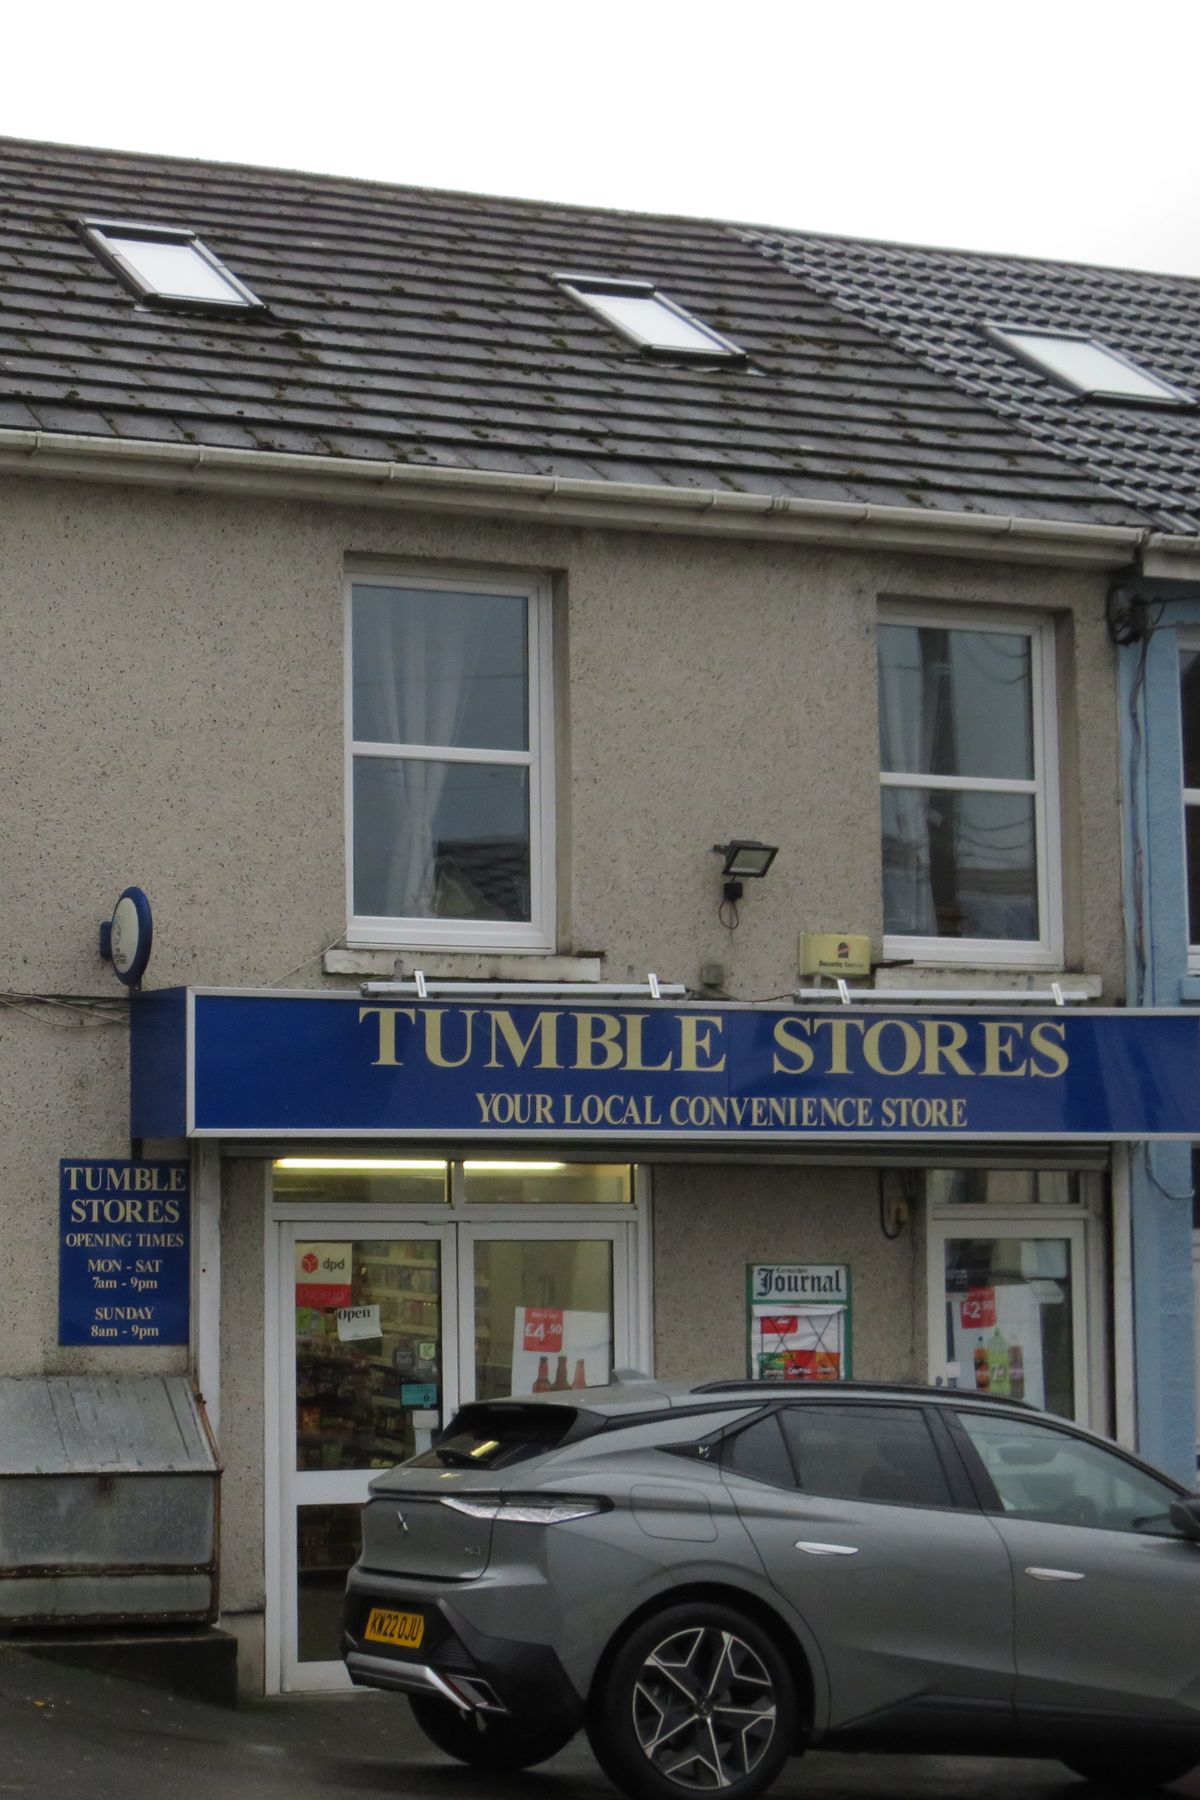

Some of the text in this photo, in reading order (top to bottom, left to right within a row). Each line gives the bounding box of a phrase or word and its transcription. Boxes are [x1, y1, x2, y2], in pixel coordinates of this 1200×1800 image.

[359, 1006, 1069, 1078] TUMBLE STORES
[476, 1092, 968, 1128] YOUR LOCAL CONVENIENCE STORE
[64, 1167, 187, 1192] TUMBLE
[71, 1198, 180, 1223] STORES
[65, 1232, 184, 1248] OPENING TIMES
[87, 1259, 122, 1273] MON
[135, 1259, 163, 1273] SAT
[322, 1257, 345, 1272] dpd
[92, 1277, 117, 1288] 7am
[130, 1277, 158, 1292] 9pm
[756, 1267, 843, 1297] Journal
[95, 1307, 155, 1321] SUNDAY
[337, 1308, 371, 1323] Open
[91, 1325, 118, 1337] 8am
[131, 1326, 160, 1340] 9pm
